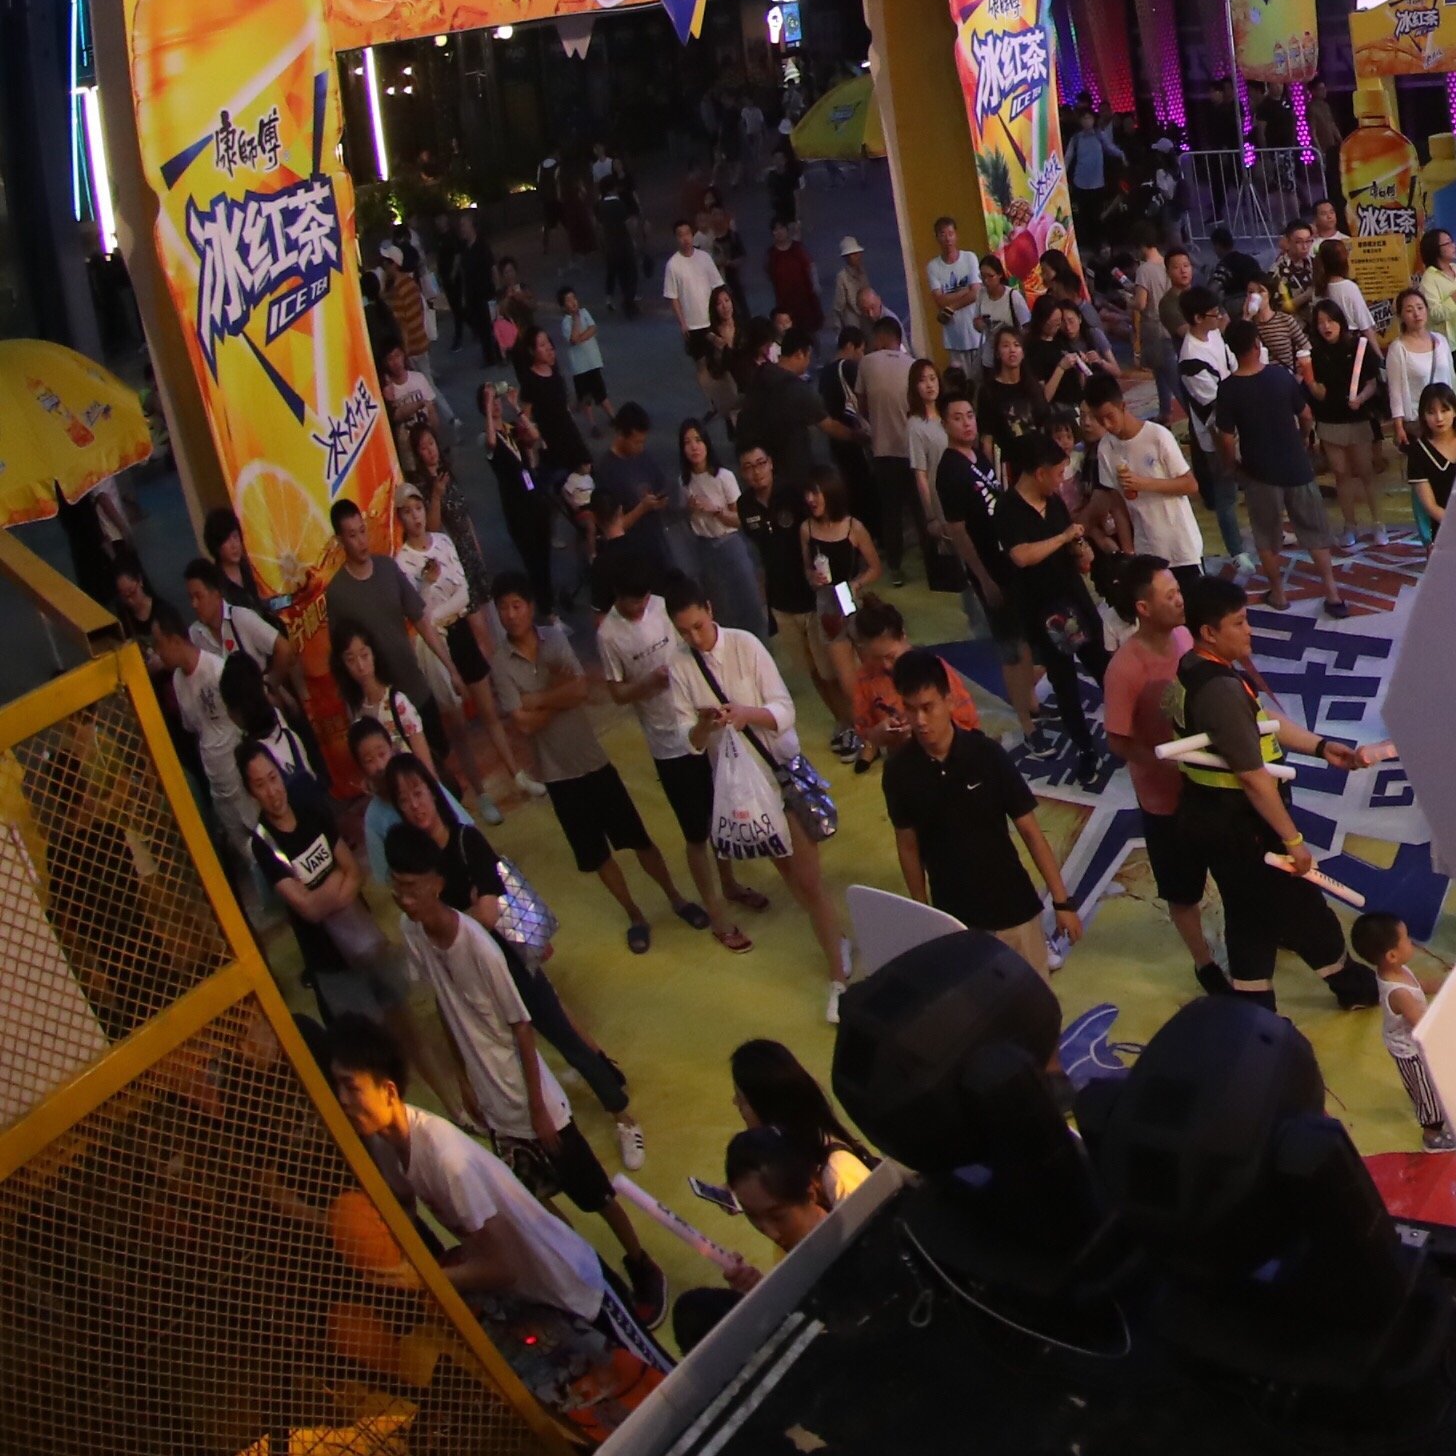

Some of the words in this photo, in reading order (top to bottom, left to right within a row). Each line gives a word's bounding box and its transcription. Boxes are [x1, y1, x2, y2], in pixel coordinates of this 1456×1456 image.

[972, 29, 1048, 128] 冰红茶
[1011, 92, 1031, 118] ICE
[1357, 206, 1417, 238] 冰红茶
[191, 184, 338, 361] 冰红茶
[270, 294, 306, 330] ICE
[307, 278, 329, 300] TEA
[300, 843, 330, 874] VANS
